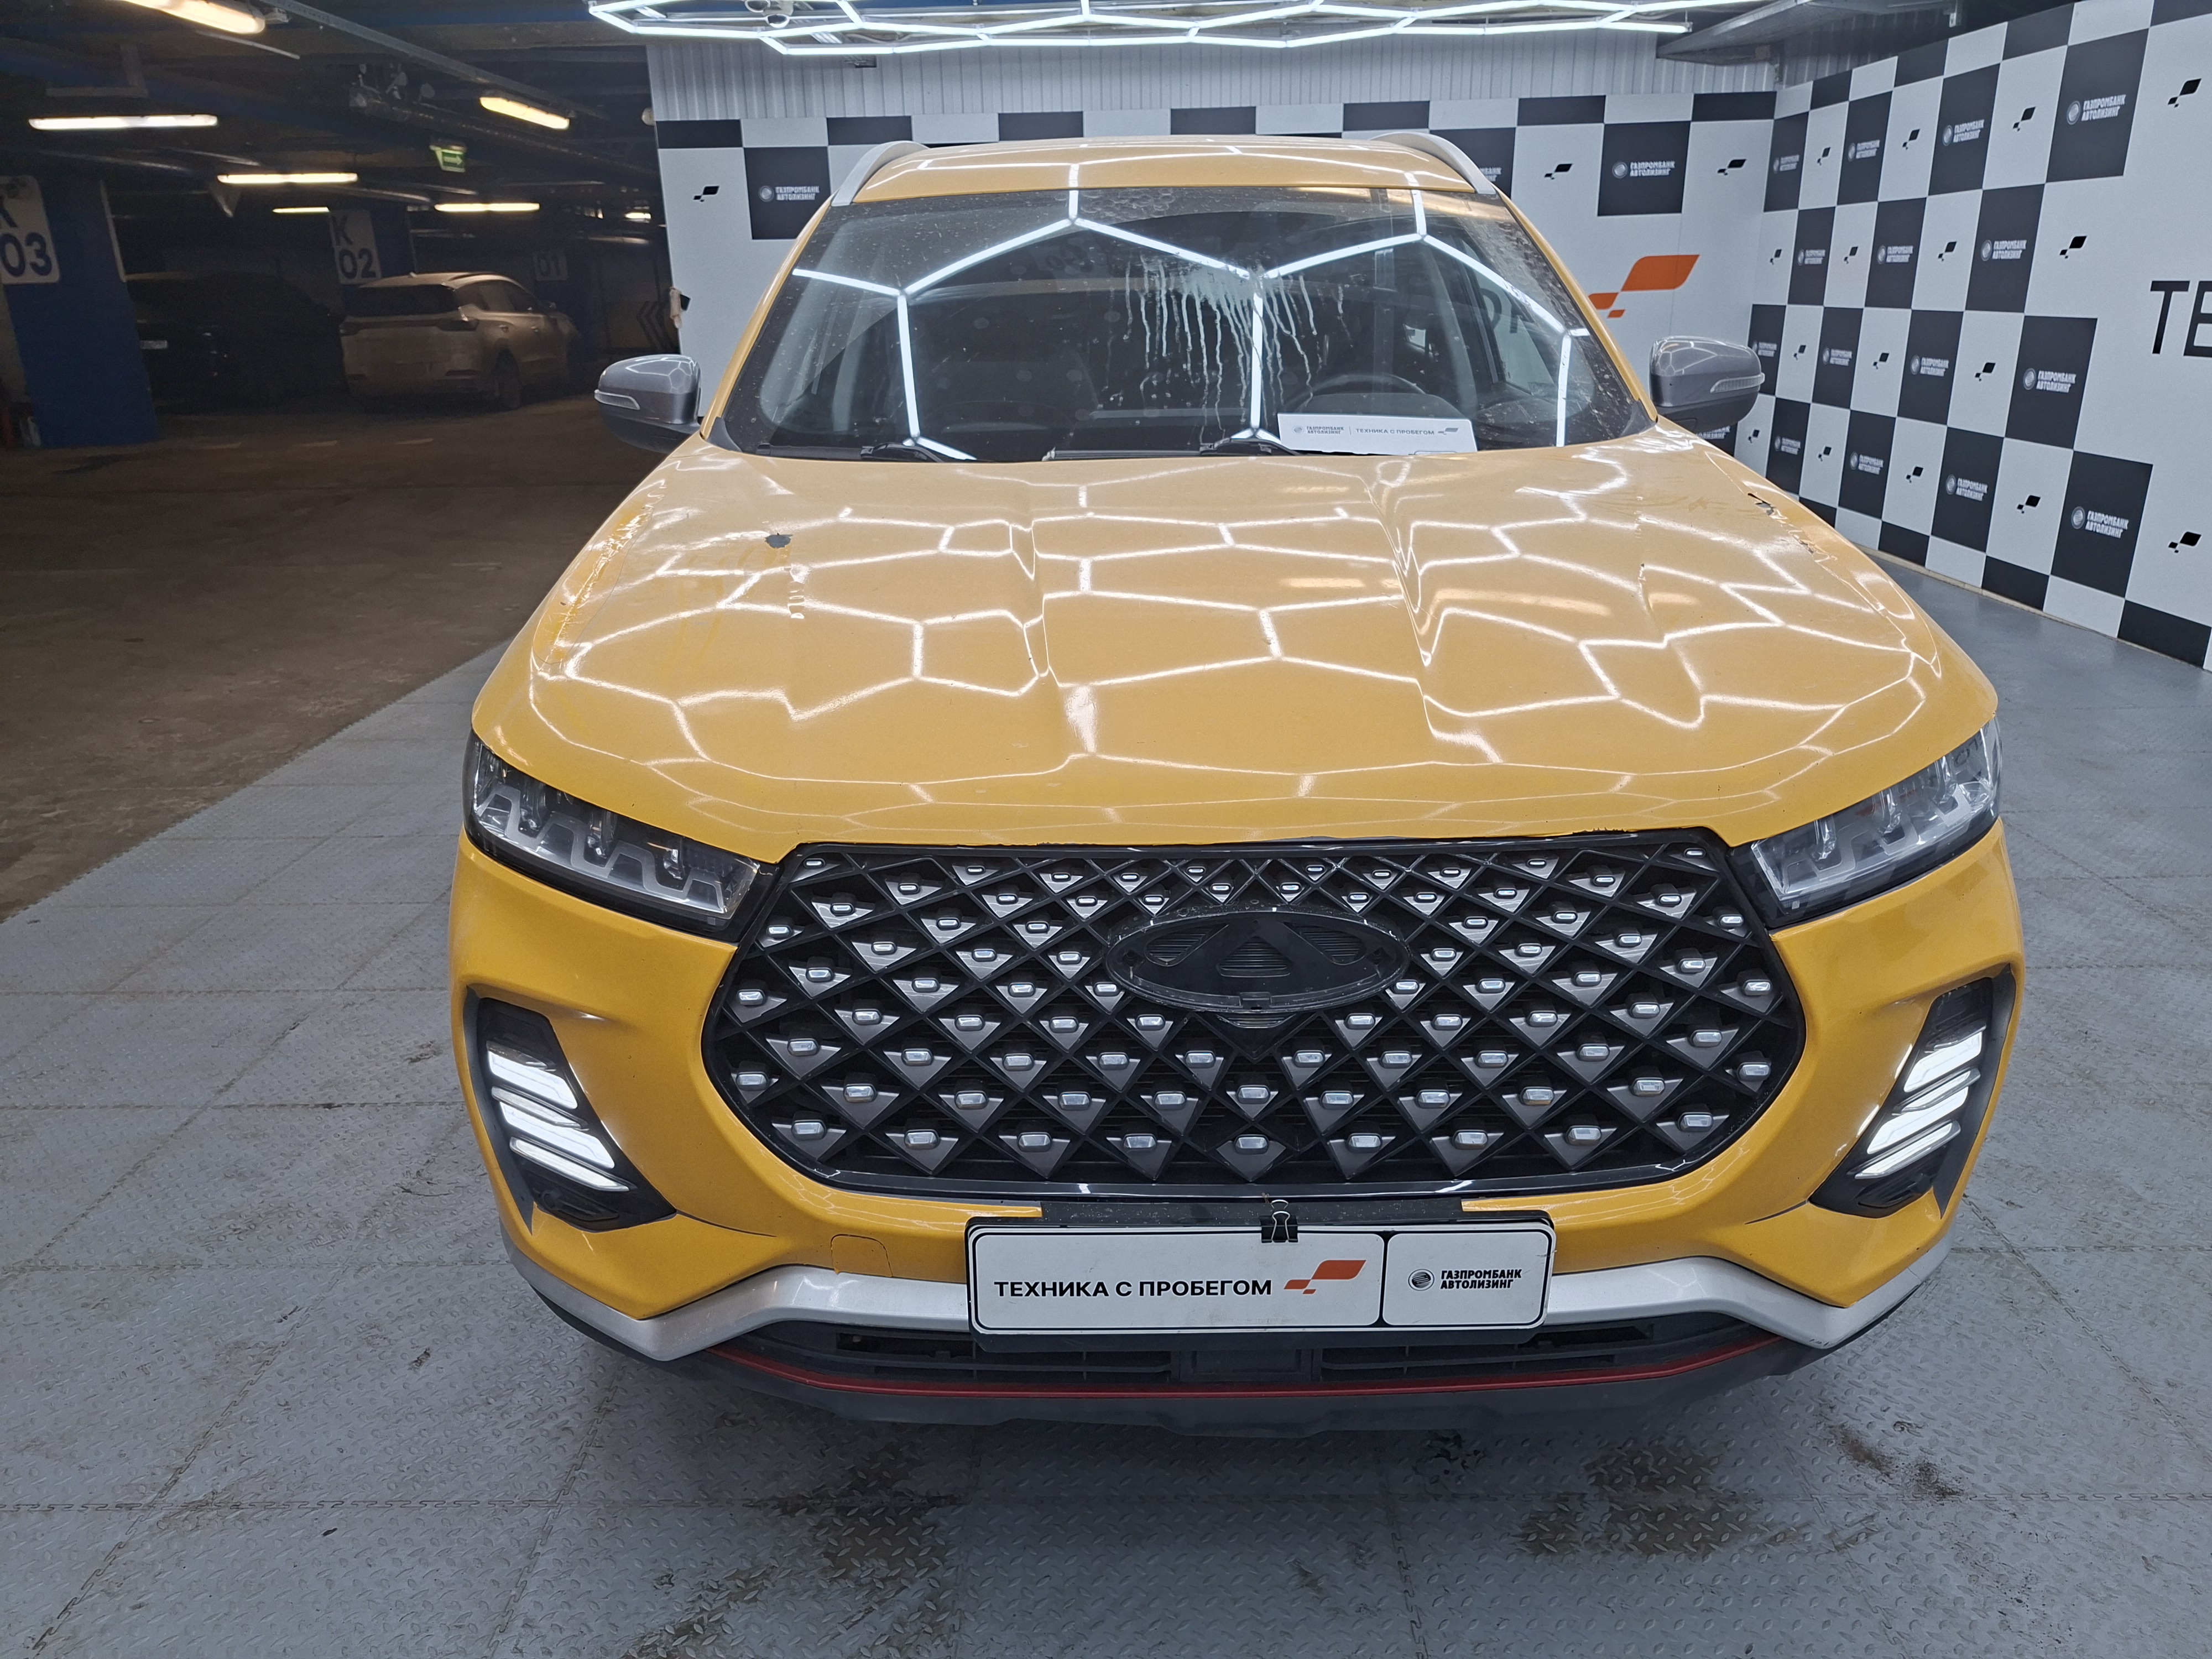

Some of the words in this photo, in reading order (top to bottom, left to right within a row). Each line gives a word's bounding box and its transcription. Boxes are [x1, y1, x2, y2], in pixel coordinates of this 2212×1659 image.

[0, 233, 53, 277] 03
[338, 248, 377, 279] 02
[1441, 1269, 1522, 1280] ГАЗПРОМБАНК
[994, 1281, 1109, 1297] ТЕХНИКА
[1116, 1281, 1132, 1297] С
[1139, 1280, 1271, 1296] ПРОБЕГОМ
[1441, 1280, 1514, 1289] АВТОЛИЗИНГ
